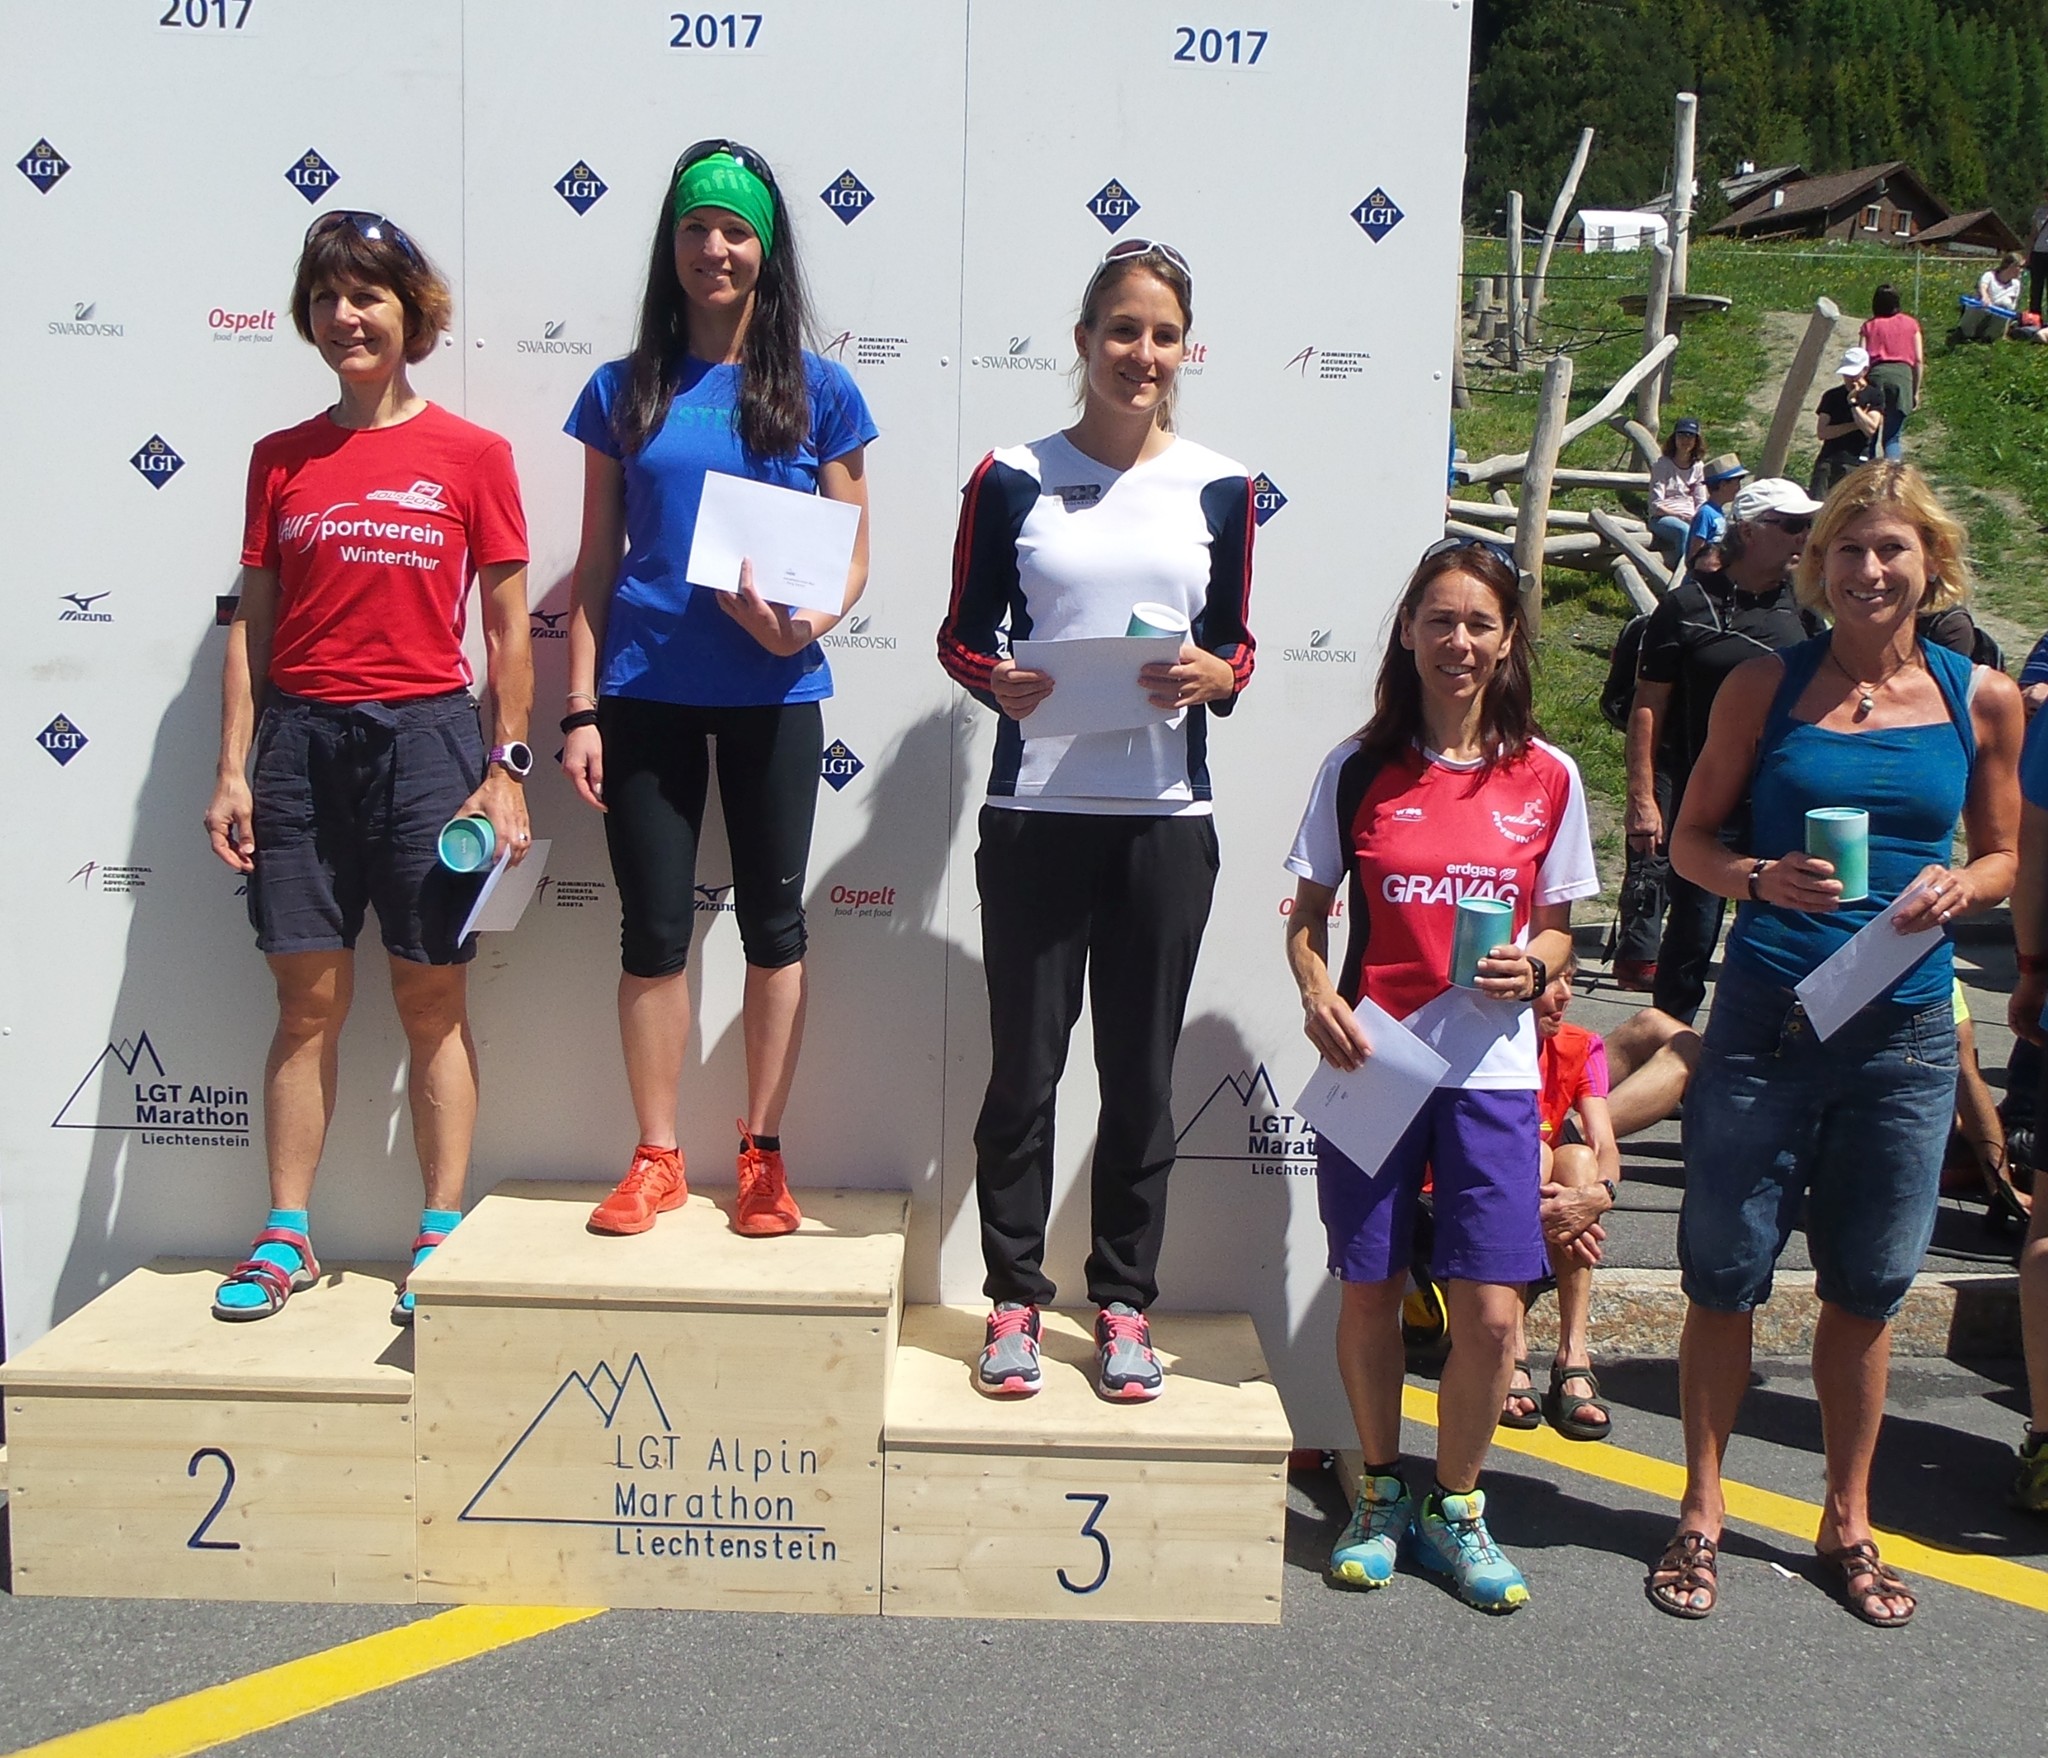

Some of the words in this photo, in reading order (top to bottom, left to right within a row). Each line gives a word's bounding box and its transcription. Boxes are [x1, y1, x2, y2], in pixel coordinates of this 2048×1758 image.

[159, 0, 251, 29] 2017
[669, 13, 763, 49] 2017
[1173, 26, 1269, 65] 2017
[26, 158, 64, 176] LGT
[293, 168, 333, 187] LGT
[563, 180, 601, 198] LGT
[829, 189, 868, 207] LGT
[1095, 198, 1134, 216] LGT
[1359, 207, 1397, 225] LGT
[208, 307, 277, 333] Ospelt
[48, 322, 124, 337] SWAROVSKI
[517, 341, 592, 355] SWAROVSKI
[981, 355, 1057, 371] SWAROVSKI
[139, 453, 177, 472] LGT
[1254, 492, 1281, 510] GT
[341, 544, 440, 571] Winterthur
[530, 627, 568, 638] MIZUN
[822, 635, 897, 650] SWAROVSKI
[1283, 648, 1356, 663] SWAROVSKI
[44, 732, 82, 749] LGT
[821, 758, 857, 774] LGT
[1445, 862, 1497, 878] erdgas
[830, 885, 896, 909] Ospelt
[1382, 873, 1520, 905] GRAVAG
[835, 907, 853, 917] food
[859, 908, 872, 919] pet
[873, 909, 892, 918] food
[135, 1083, 182, 1103] LGT
[188, 1085, 248, 1108] Alpin
[136, 1104, 248, 1126] Marathon
[1249, 1114, 1295, 1134] LGT
[142, 1133, 250, 1147] Liechtenstein
[1248, 1135, 1316, 1155] Marat
[1252, 1163, 1318, 1176] Liechten
[616, 1434, 681, 1471] LGT
[707, 1437, 817, 1483] Alpin
[187, 1447, 241, 1550] 2
[615, 1482, 795, 1520] Marathon
[615, 1528, 837, 1560] Liechtenstein
[1056, 1493, 1111, 1594] 3
